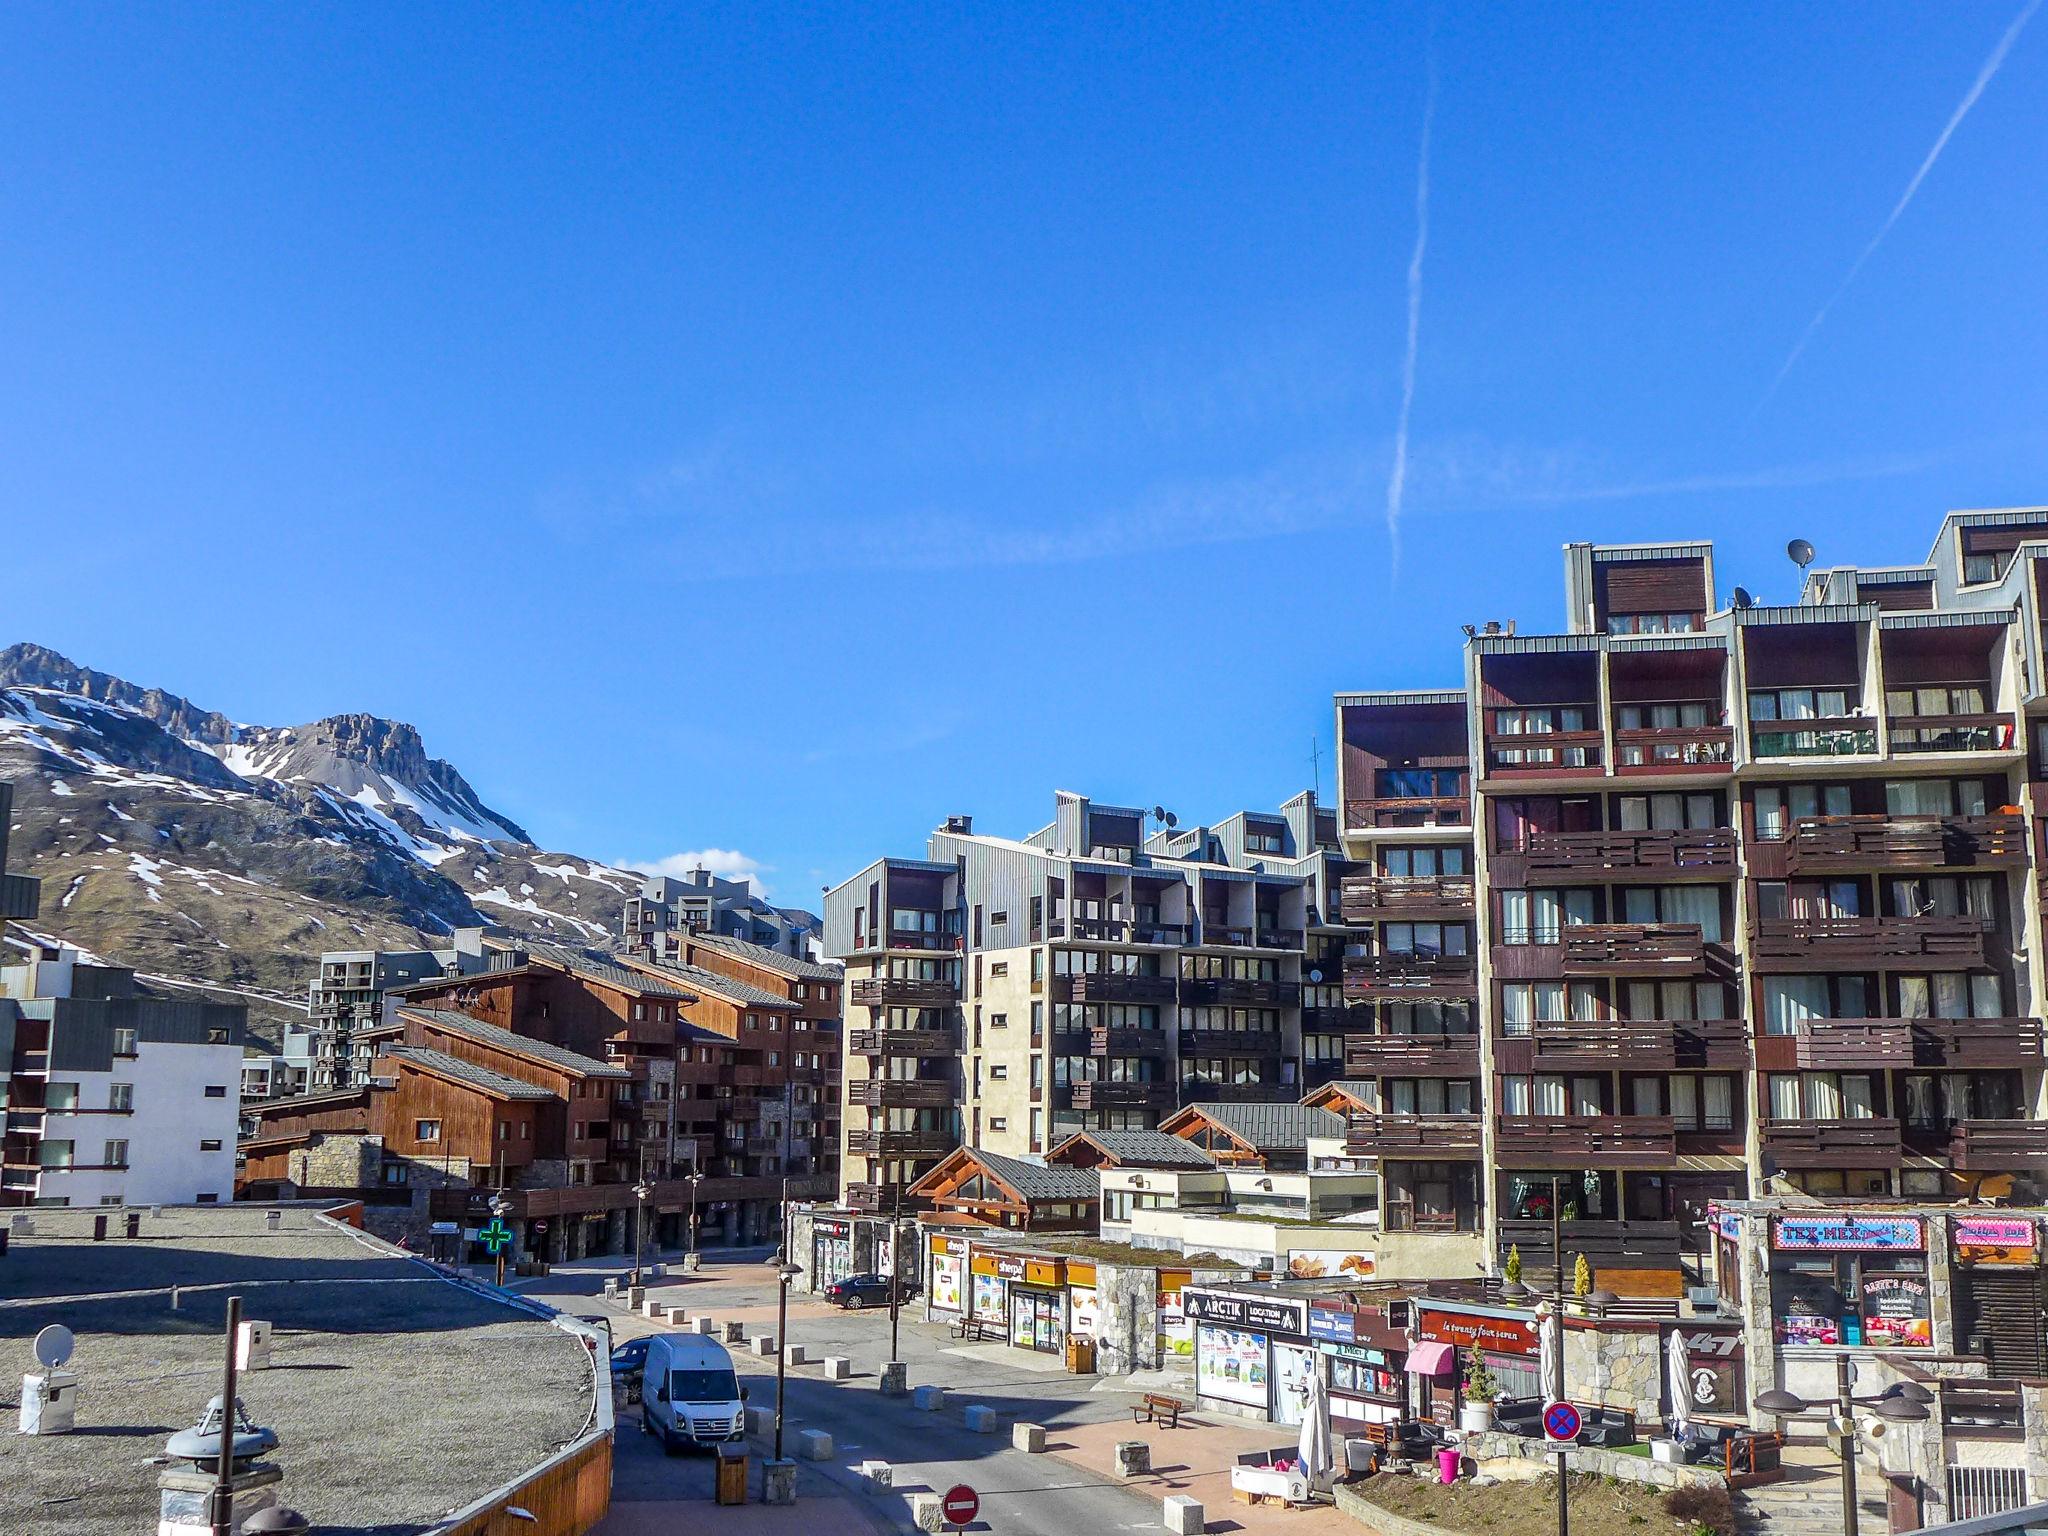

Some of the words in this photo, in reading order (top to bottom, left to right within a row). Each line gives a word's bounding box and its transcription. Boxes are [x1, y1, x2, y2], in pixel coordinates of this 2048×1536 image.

[1784, 1226, 1860, 1240] TEX-MEX
[947, 1240, 964, 1253] sherp
[999, 1261, 1022, 1275] sherpa
[1205, 1299, 1241, 1316] ARCTIK
[1249, 1306, 1280, 1319] LOCATION
[1450, 1323, 1477, 1339] twenty
[1477, 1325, 1494, 1340] four
[1495, 1331, 1518, 1341] seven
